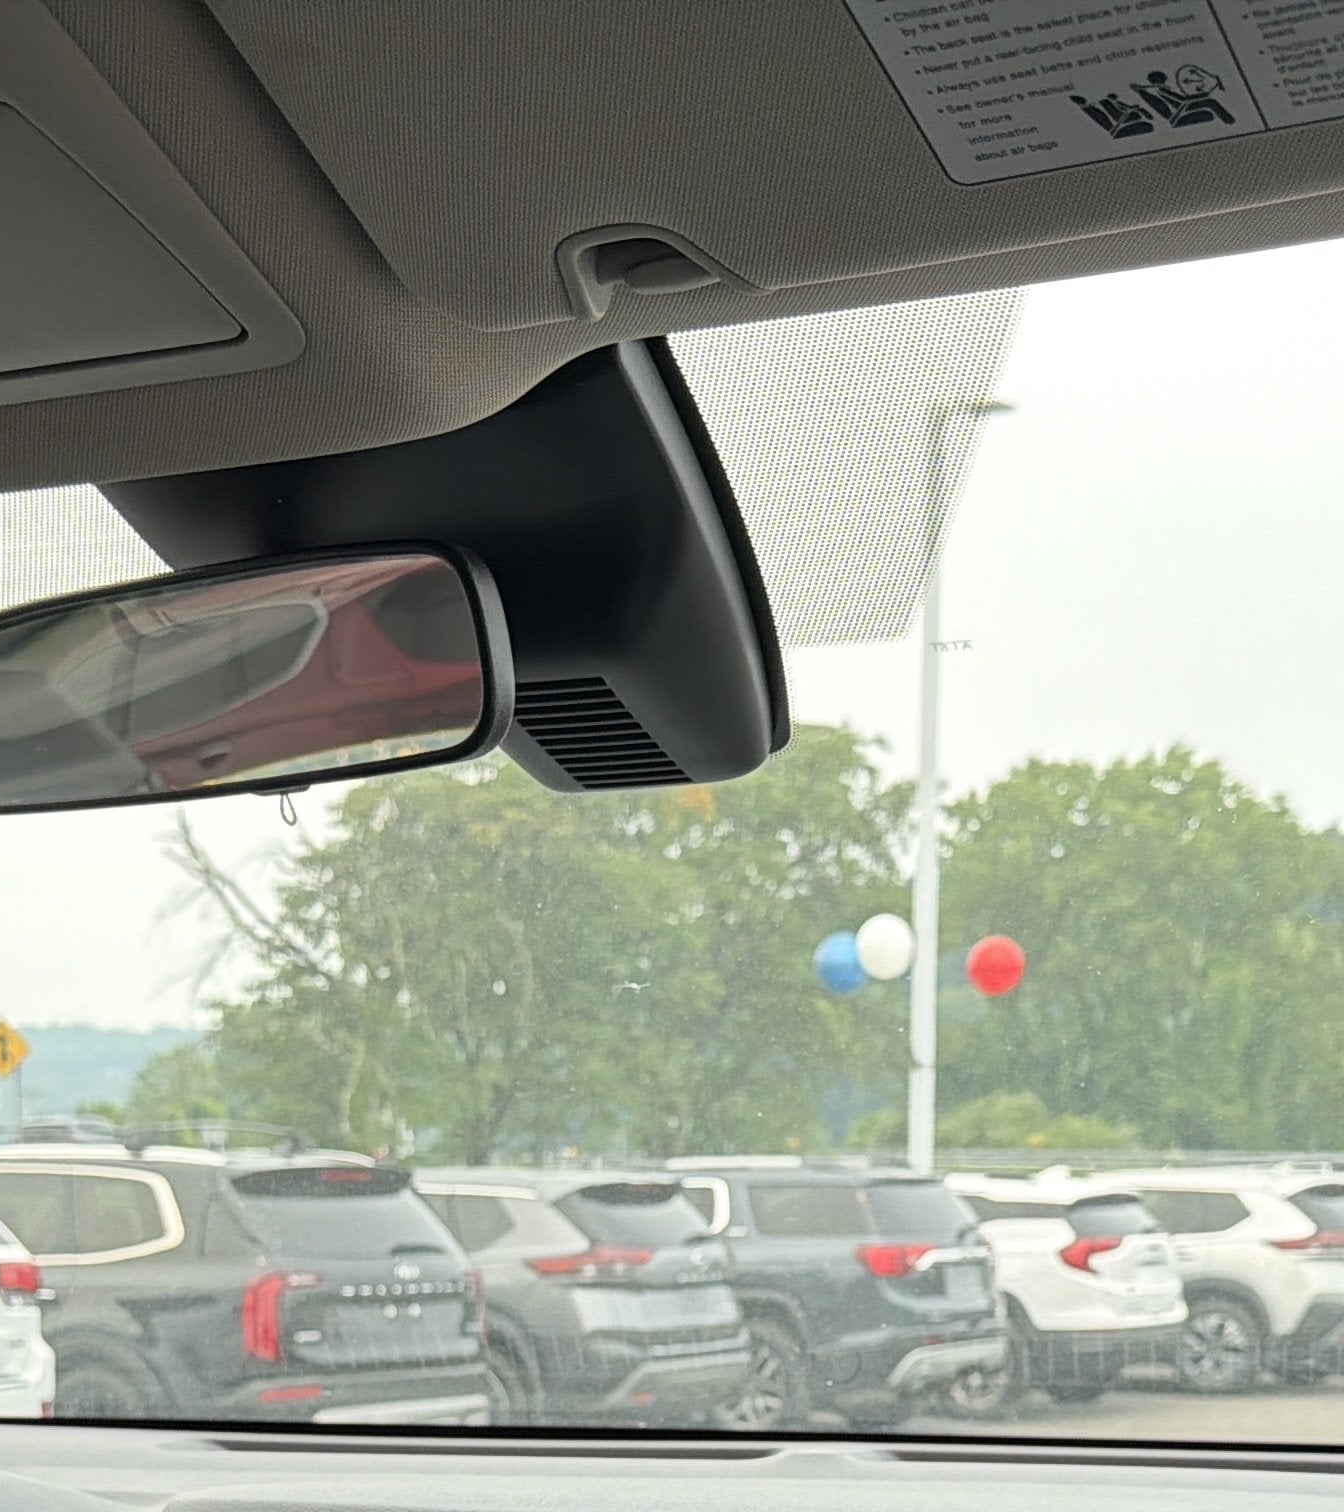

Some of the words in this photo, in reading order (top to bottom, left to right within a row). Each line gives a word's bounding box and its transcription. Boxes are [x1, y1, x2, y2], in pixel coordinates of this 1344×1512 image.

[892, 5, 948, 22] Children
[950, 1, 974, 12] can
[900, 27, 917, 37] by
[919, 23, 941, 32] the
[945, 18, 960, 28] air
[964, 12, 990, 24] bag
[911, 44, 937, 55] The
[937, 38, 968, 50] back
[970, 32, 997, 44] seat
[999, 29, 1011, 38] is
[1012, 25, 1033, 35] the
[1077, 10, 1112, 24] place
[1113, 4, 1131, 15] for
[922, 62, 958, 74] Never
[961, 56, 981, 69] put
[984, 55, 994, 63] a
[995, 41, 1062, 61] rear-facing
[1063, 33, 1093, 47] child
[1097, 27, 1124, 40] seat
[1126, 25, 1139, 34] in
[1141, 20, 1162, 31] the
[1165, 13, 1196, 26] front
[936, 79, 981, 95] Always
[983, 75, 1006, 86] use
[1009, 68, 1039, 80] seat
[1077, 54, 1102, 67] and
[1105, 48, 1137, 62] child
[1141, 35, 1205, 53] restraints
[946, 103, 972, 114] See
[975, 93, 1025, 109] owner's
[1027, 82, 1075, 98] manual
[958, 119, 976, 130] for
[980, 113, 1013, 127] more
[968, 125, 1039, 146] information
[974, 150, 1008, 163] about
[1011, 145, 1026, 156] air
[1027, 140, 1059, 153] bags
